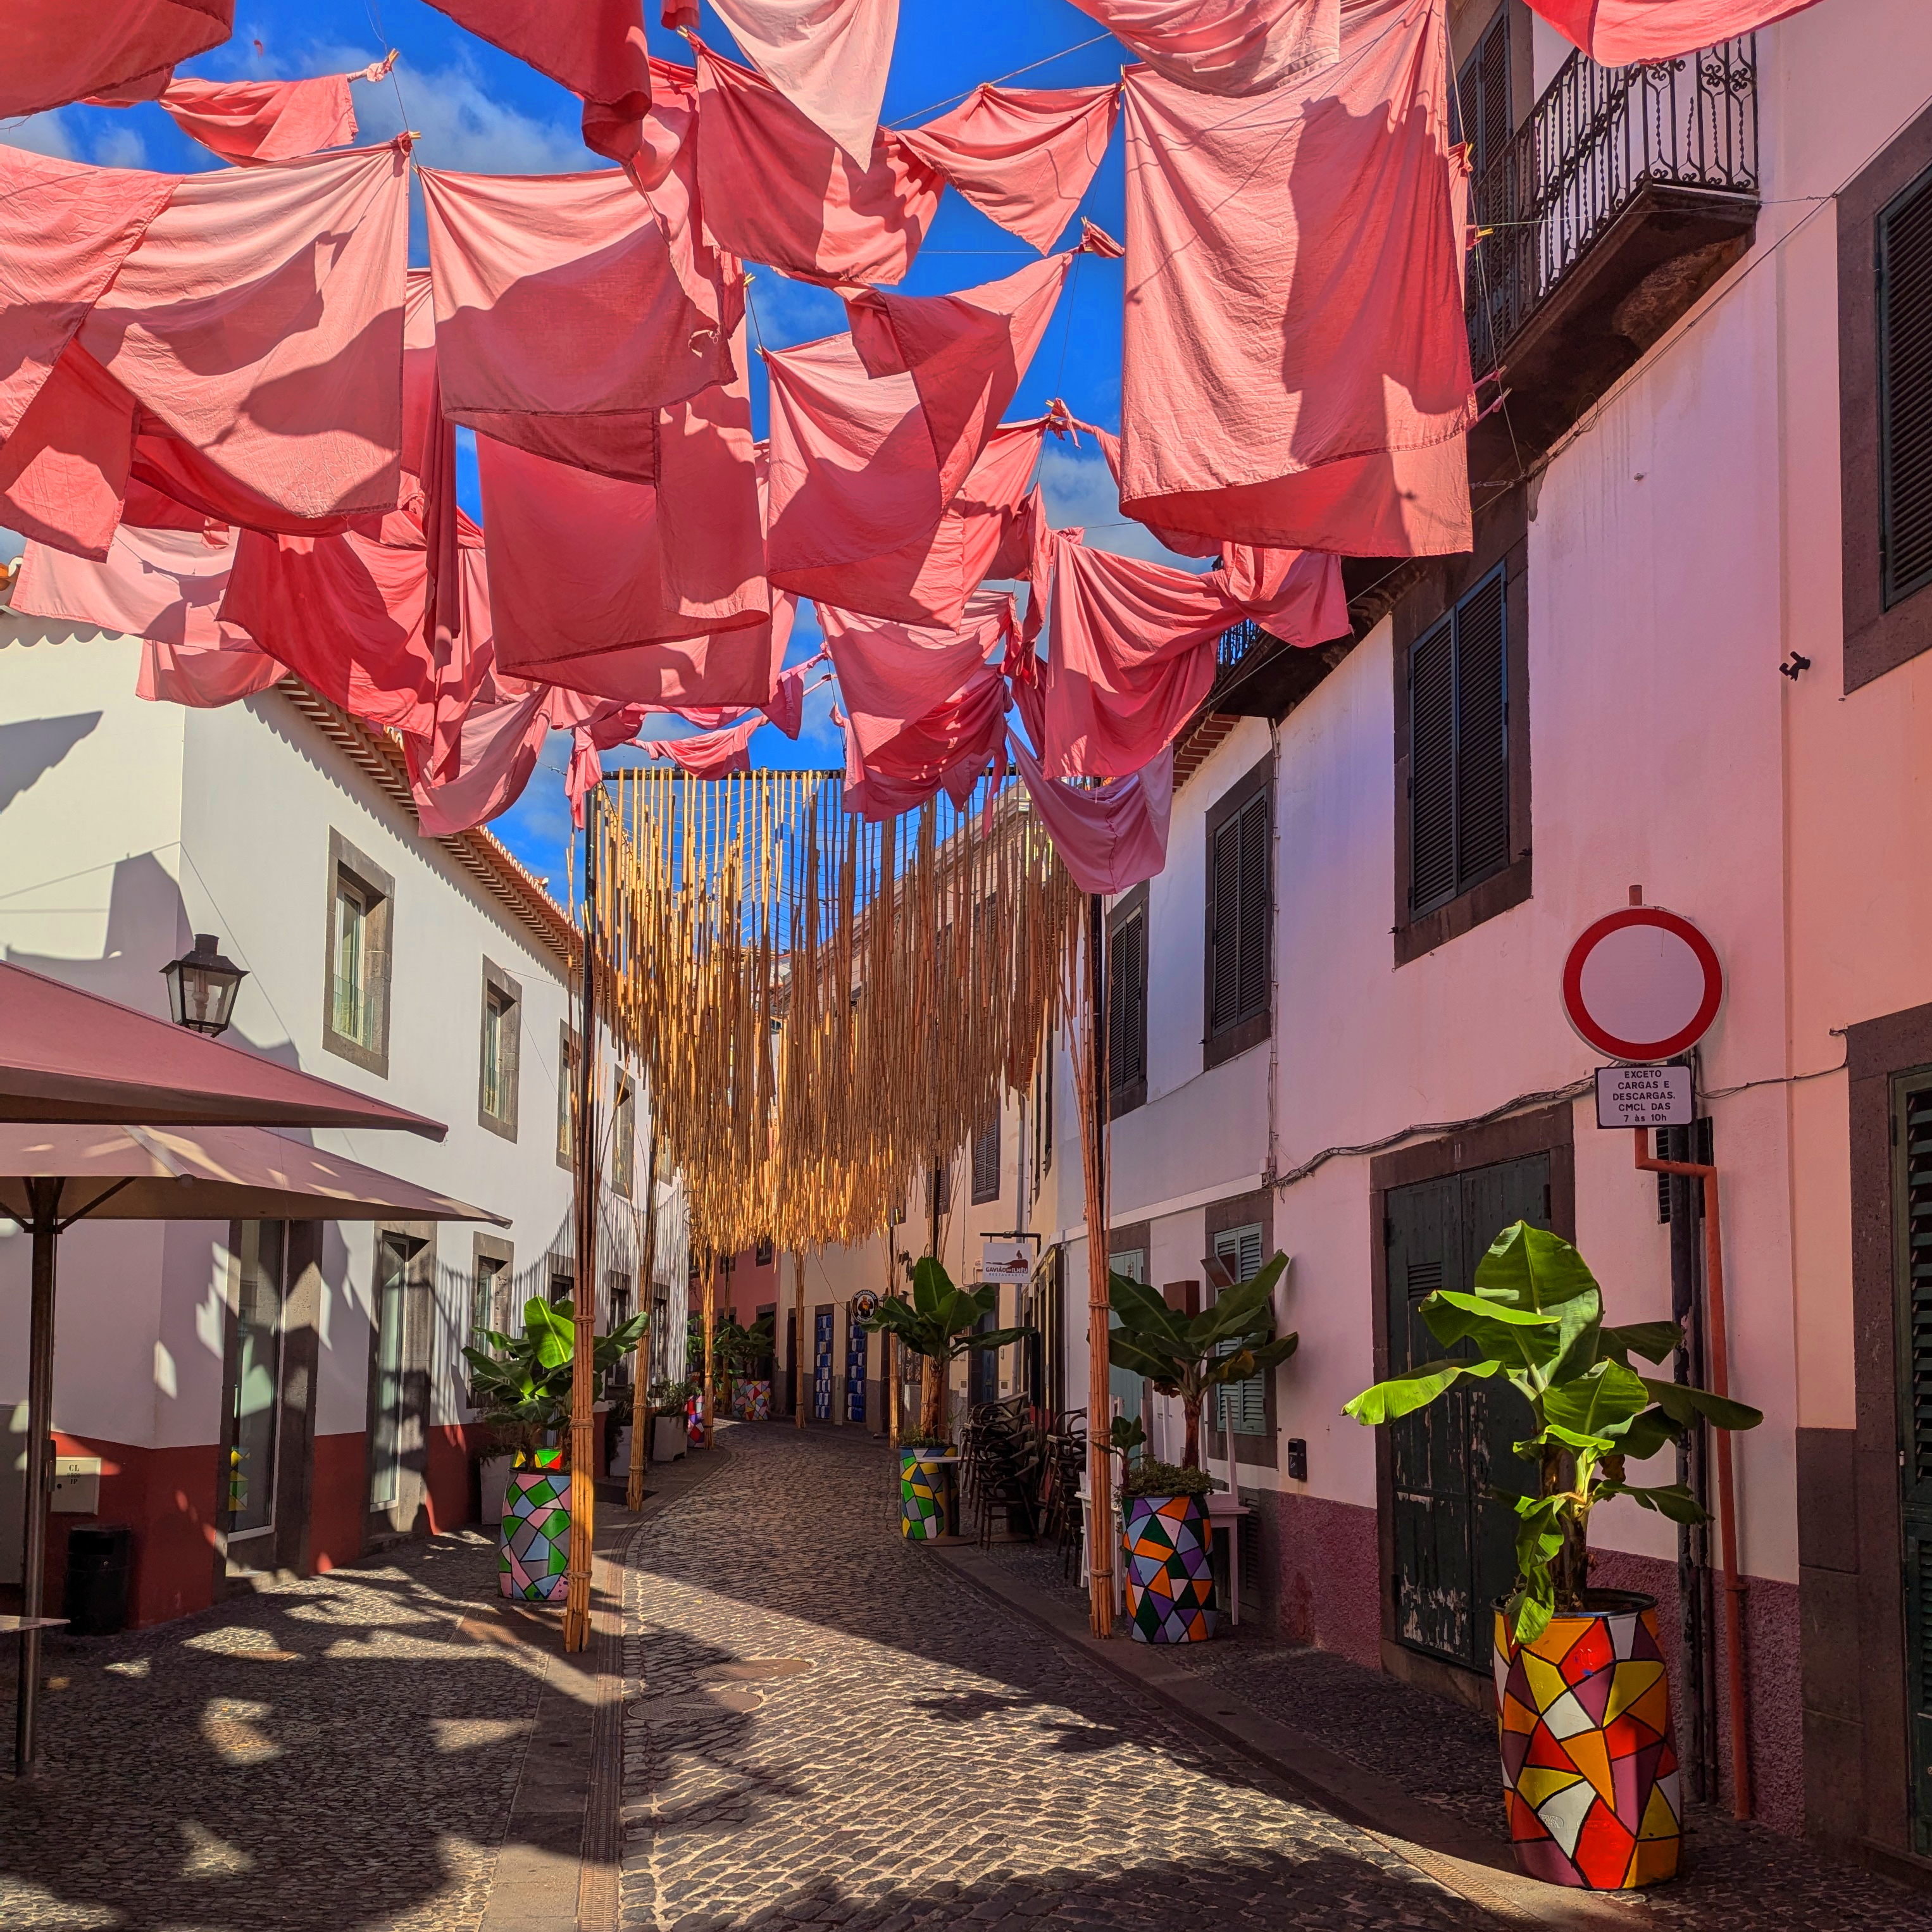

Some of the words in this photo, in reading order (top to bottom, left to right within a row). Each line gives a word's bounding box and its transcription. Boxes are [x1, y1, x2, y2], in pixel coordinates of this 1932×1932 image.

[1624, 1069, 1662, 1079] EXCETO
[1617, 1081, 1659, 1090] CARGAS
[1664, 1080, 1670, 1088] E
[1618, 1103, 1646, 1112] CMCL
[1651, 1102, 1671, 1111] DAS
[1623, 1114, 1629, 1123] 7
[1635, 1113, 1645, 1122] às
[1651, 1113, 1667, 1122] 10h
